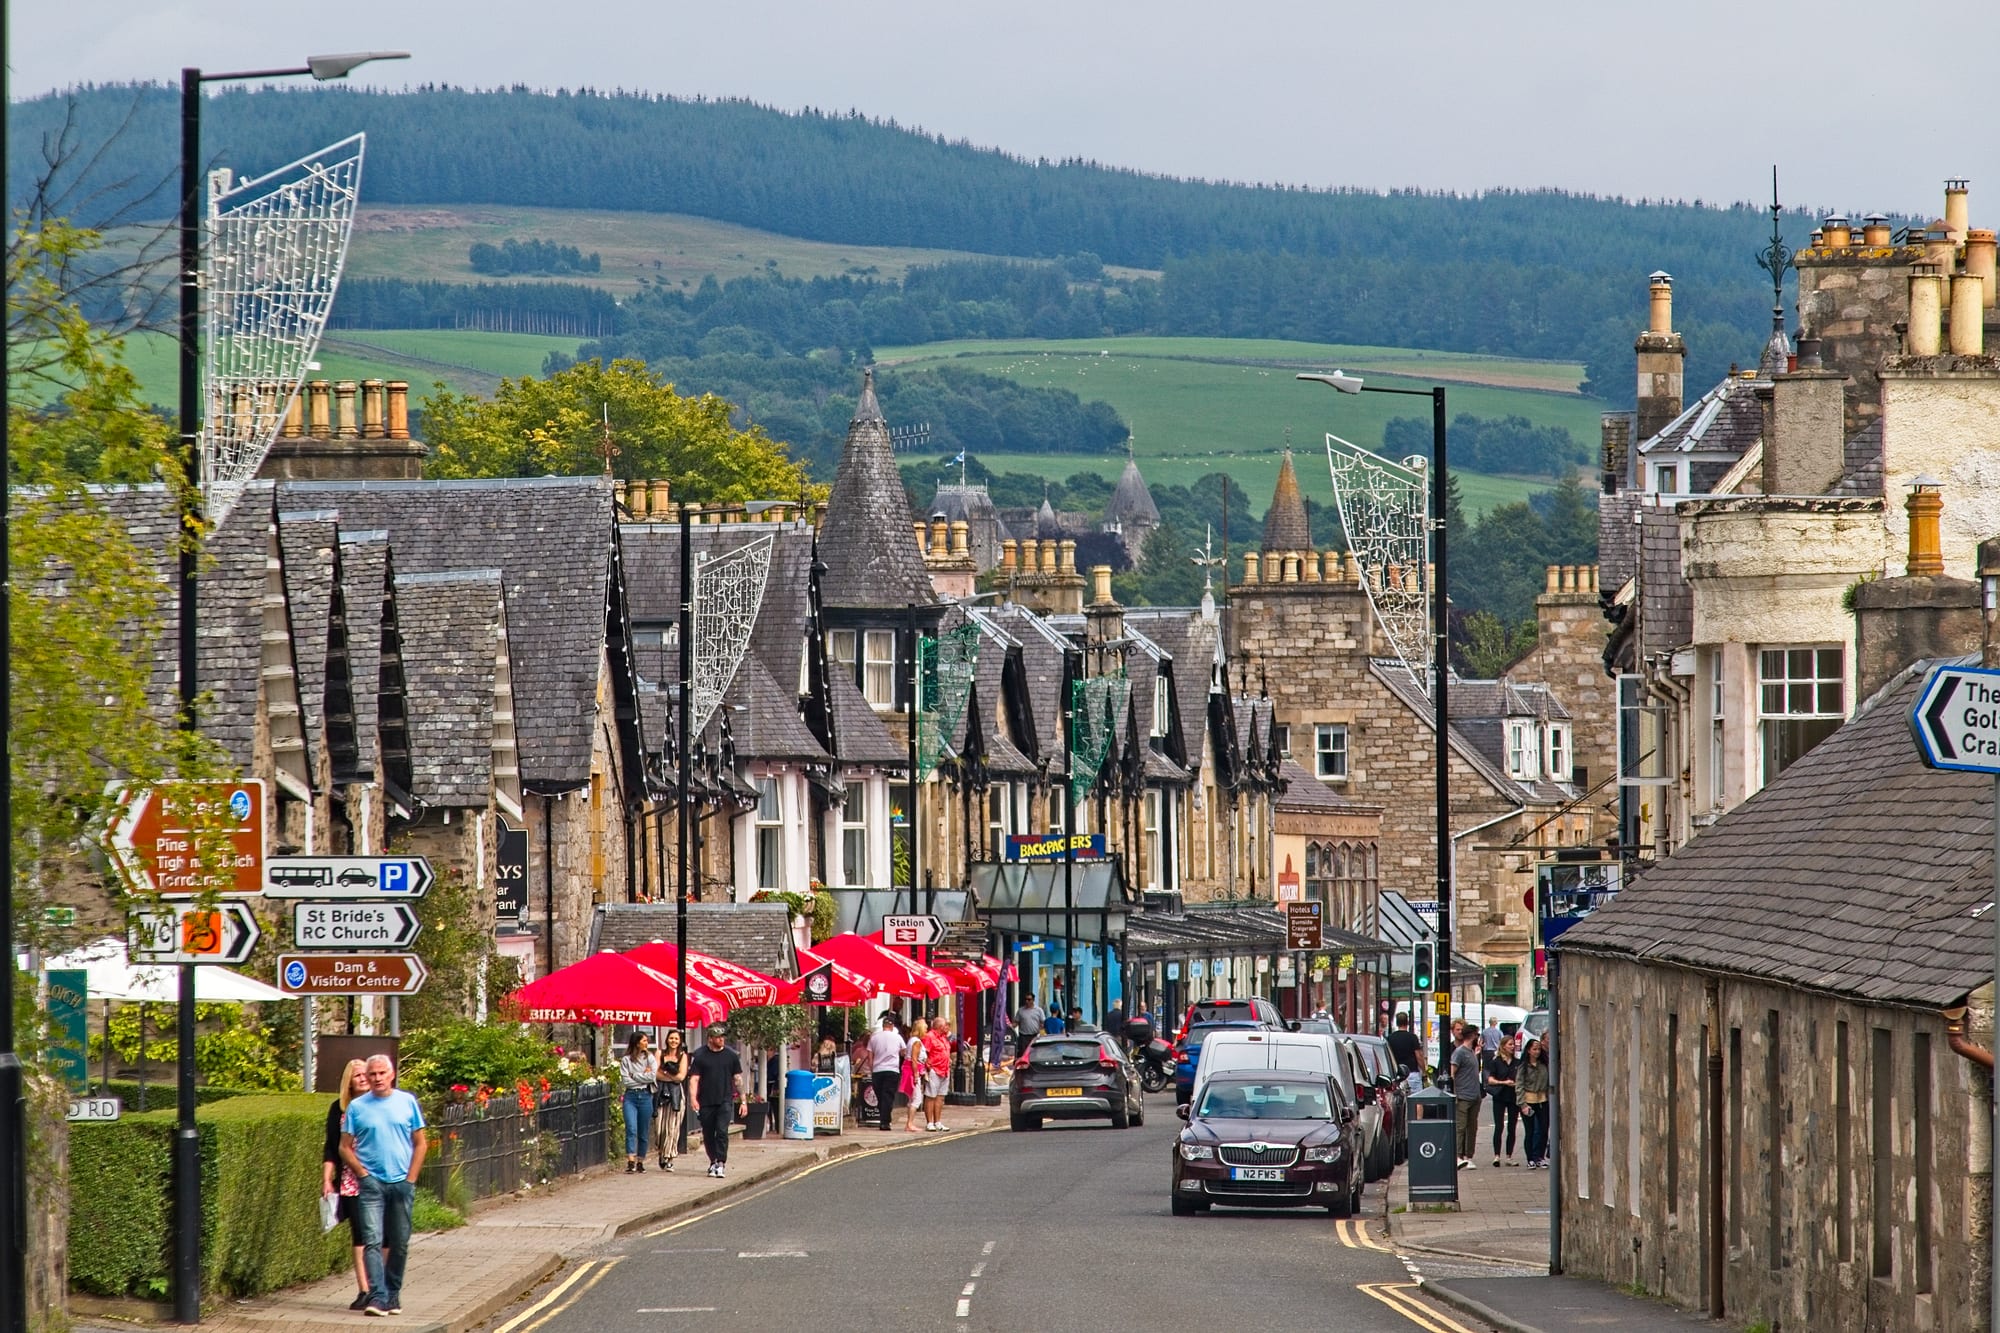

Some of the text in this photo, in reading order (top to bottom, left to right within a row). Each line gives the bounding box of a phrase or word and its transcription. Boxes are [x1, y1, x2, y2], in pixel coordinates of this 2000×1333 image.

[1965, 682, 2000, 704] The
[1963, 707, 1999, 730] Gol
[1962, 733, 2000, 756] Cra
[156, 838, 188, 852] Pine
[1020, 835, 1092, 858] BACKPACERS
[156, 855, 185, 872] Tigh
[384, 865, 403, 889] P
[497, 886, 509, 896] ar
[307, 909, 385, 923] St Bride's
[1289, 906, 1311, 914] Hotels
[889, 918, 925, 928] Station
[303, 925, 389, 939] RC Church
[334, 961, 377, 973] Dam &
[310, 975, 401, 988] Visitor Centre
[50, 984, 83, 1009] OICH
[529, 1008, 652, 1023] BIRRA ORETTI
[88, 1102, 114, 1117] RD
[1243, 1169, 1277, 1180] N2 FWS
